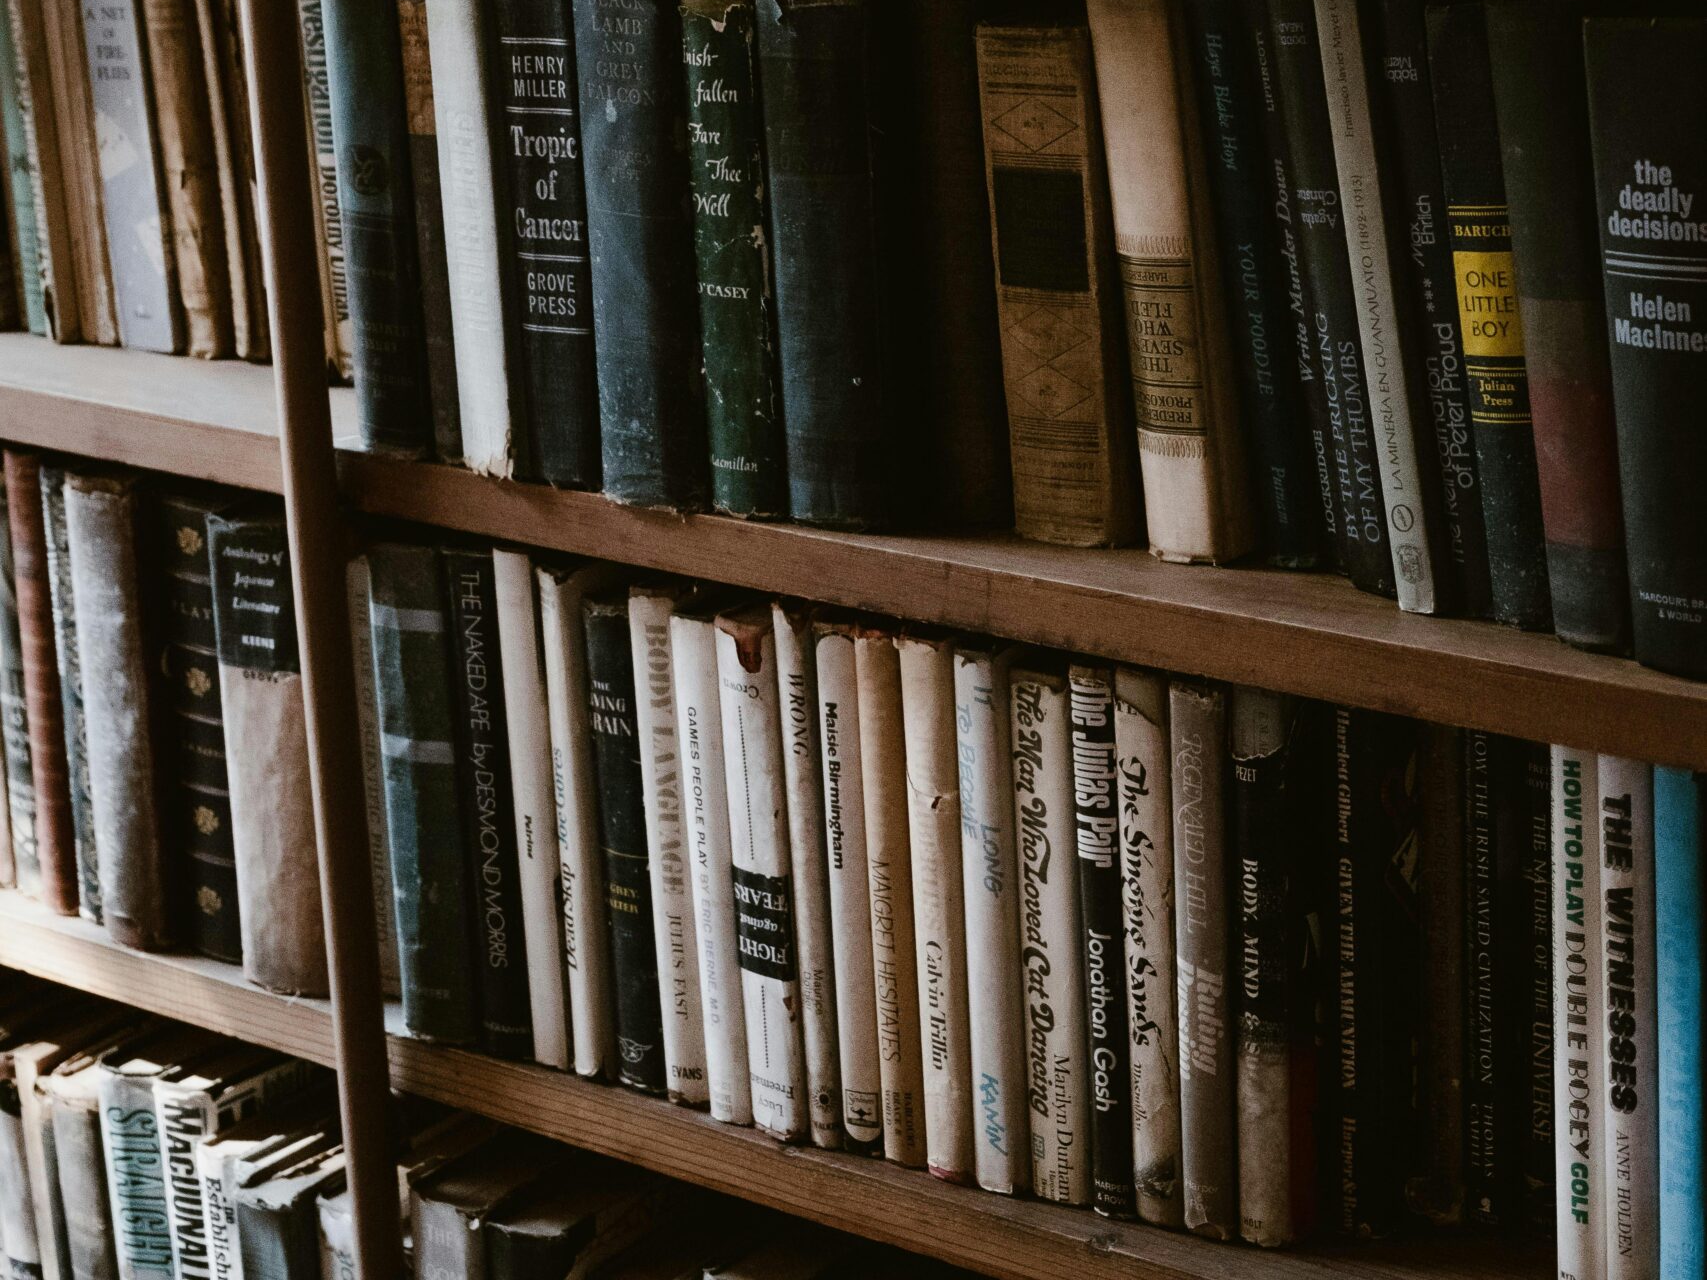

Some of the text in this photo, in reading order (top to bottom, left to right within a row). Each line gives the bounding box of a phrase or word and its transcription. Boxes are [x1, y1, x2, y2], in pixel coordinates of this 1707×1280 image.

[86, 8, 126, 21] A NET
[511, 56, 565, 75] HENRY
[513, 79, 567, 99] MILLER
[587, 83, 656, 106] FALCON
[693, 78, 738, 107] fallen
[510, 125, 577, 164] Tropic
[688, 122, 721, 145] Fare
[536, 169, 559, 200] of
[705, 156, 743, 184] Thee
[1634, 160, 1672, 186] the
[692, 191, 731, 218] Well
[1618, 185, 1693, 218] deadly
[515, 207, 584, 241] Cancer
[1416, 195, 1435, 244] Ehrlich
[1454, 225, 1511, 237] BARUCH
[1608, 211, 1707, 242] decisions
[1409, 223, 1425, 267] Max
[527, 272, 576, 293] GROVE
[697, 282, 751, 299] O'CASEY
[1466, 271, 1508, 288] ONE
[528, 295, 577, 316] PRESS
[1238, 242, 1275, 395] YOUR POODLE
[1465, 295, 1514, 313] LITTLE
[1630, 291, 1691, 322] Helen
[1137, 319, 1173, 335] WHO
[1472, 321, 1509, 337] BOY
[1315, 312, 1360, 541] BY THE PRICKING
[1338, 341, 1380, 543] OF MY THUMBS
[1312, 429, 1336, 534] LOCKRIDGE
[222, 545, 285, 567] Anthology of
[232, 597, 281, 615] Literature
[241, 634, 275, 650] KEENE
[788, 673, 809, 758] WRONG
[460, 571, 508, 970] THE NAKED APE by DESMOND MORRIS
[825, 702, 843, 870] Maisie Birmingham
[1071, 679, 1119, 869] The Judas Pair
[1236, 765, 1257, 783] PEZET
[979, 823, 1003, 900] LONG
[734, 881, 788, 912] FEARS
[739, 912, 778, 933] against
[738, 935, 788, 965] FIGHT
[871, 860, 901, 1064] MAIGRET HESITATES
[1603, 793, 1638, 1115] THE WITNESSES
[926, 940, 944, 1009] Calvin
[1339, 857, 1356, 1089] GIVEN THE AMMUNITION
[1563, 760, 1590, 1225] HOW TO PLAY DOUBLE BOGEY GOLF
[1088, 928, 1118, 1112] Jonathan Gash
[930, 1012, 948, 1070] Trillin
[672, 1065, 702, 1080] EVANS
[1054, 1054, 1075, 1203] Marilyn Durham
[1484, 1102, 1495, 1177] THOMAS
[107, 1106, 174, 1277] STRAIGHT
[1616, 1131, 1633, 1258] ANNE HOLDEN
